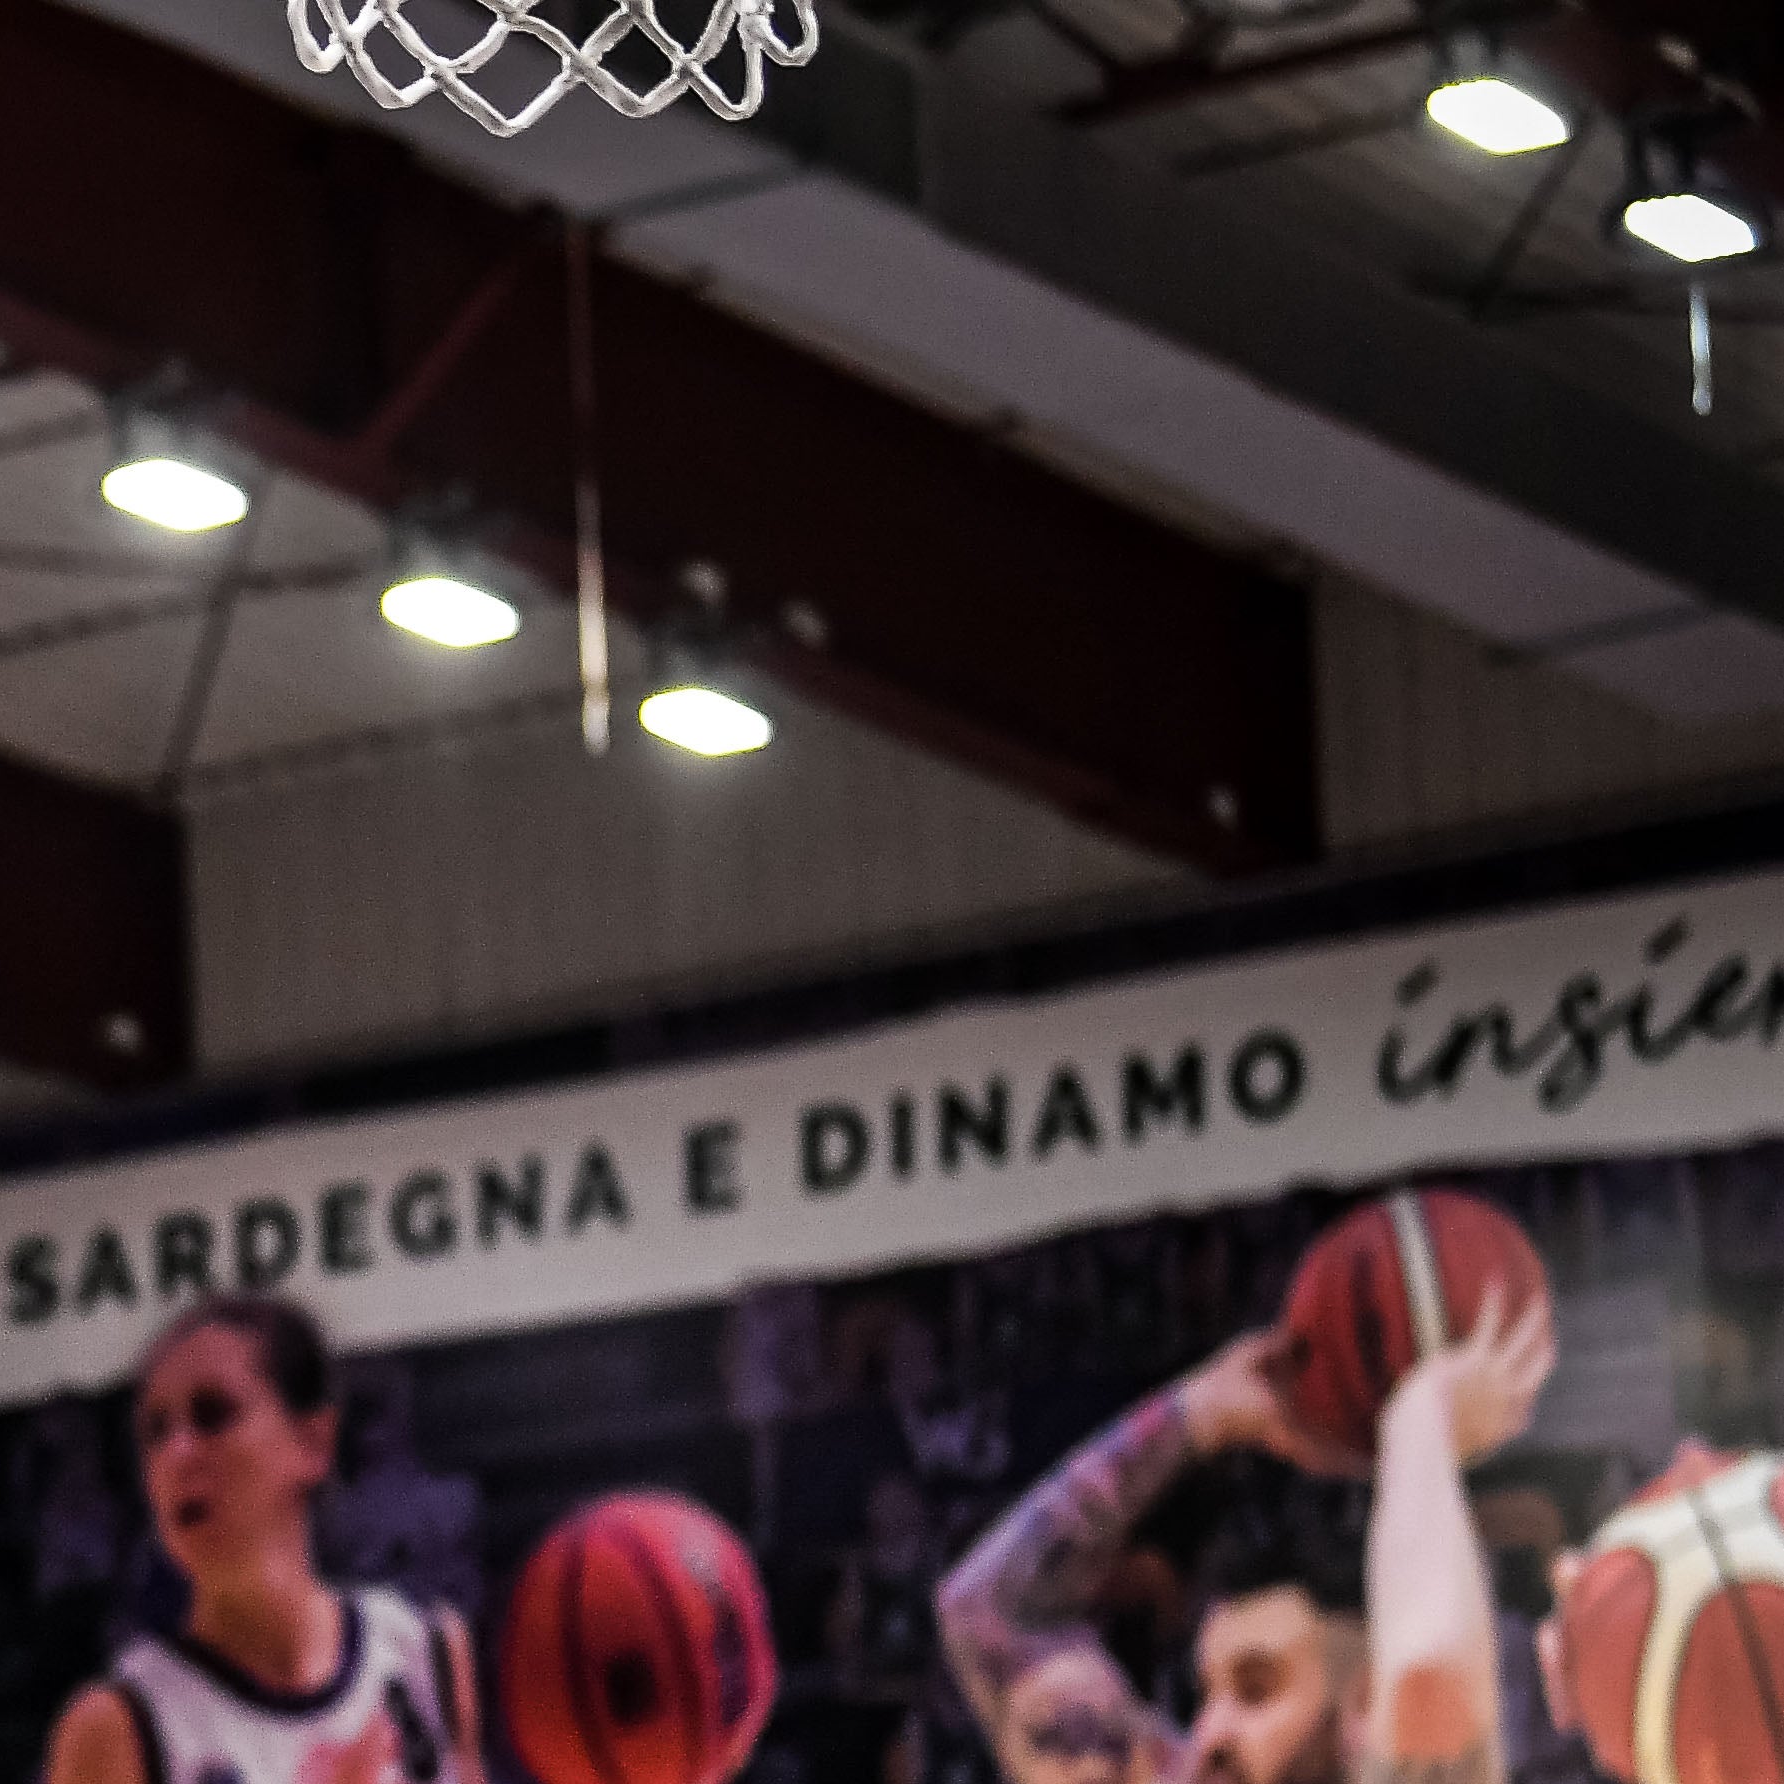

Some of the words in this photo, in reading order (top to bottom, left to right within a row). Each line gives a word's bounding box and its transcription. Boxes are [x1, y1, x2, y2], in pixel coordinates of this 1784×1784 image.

[7, 1141, 631, 1325] SARDEGNA
[681, 1121, 744, 1210] E
[798, 1028, 1308, 1191] DINAMO
